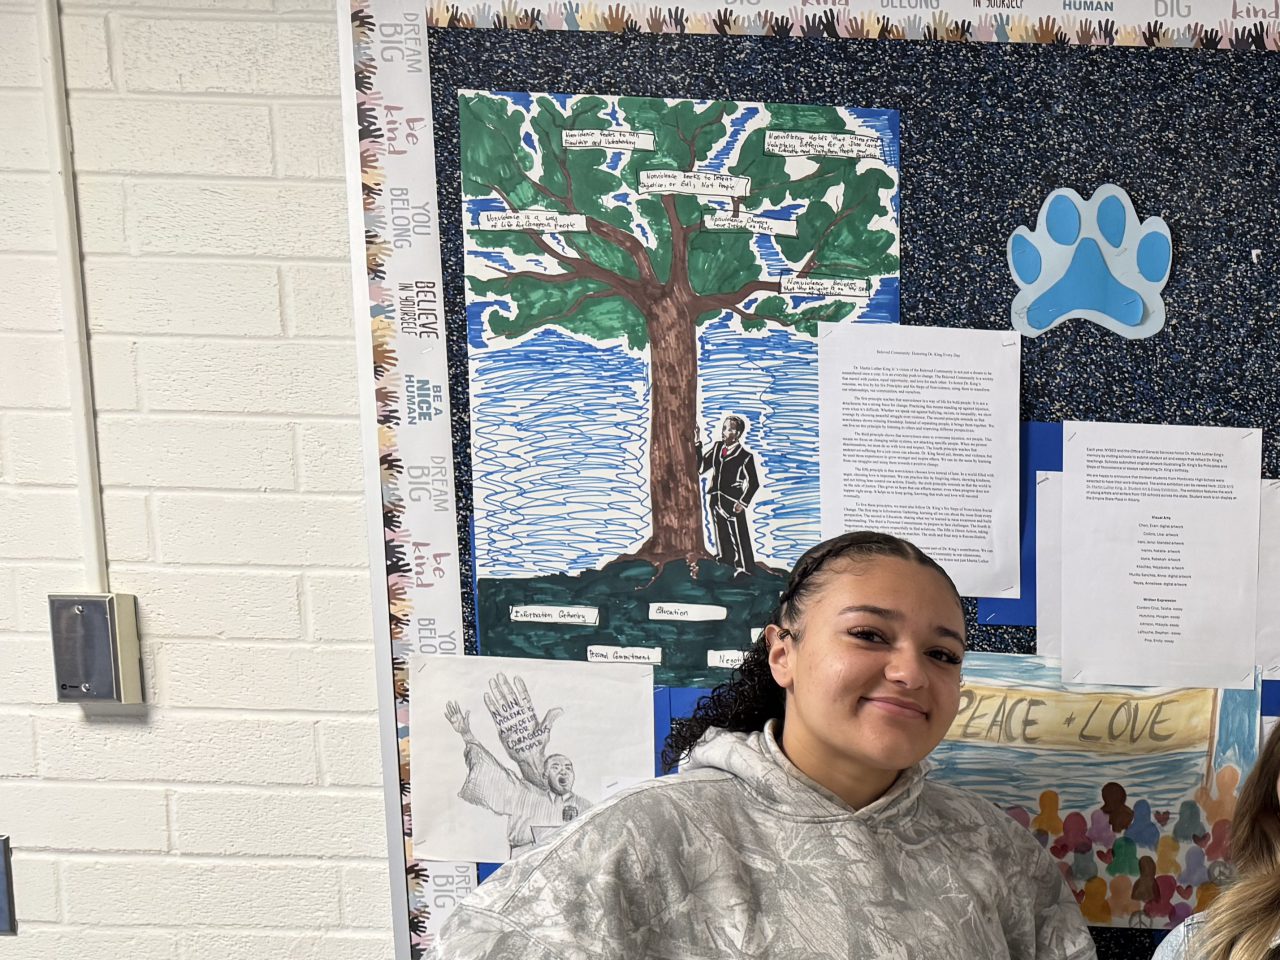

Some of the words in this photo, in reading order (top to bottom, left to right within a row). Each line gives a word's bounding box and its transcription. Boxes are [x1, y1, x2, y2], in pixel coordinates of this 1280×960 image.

[1062, 0, 1113, 12] HUMAN
[1154, 0, 1191, 18] BIG
[1231, 0, 1279, 20] kind
[379, 22, 405, 63] BIG
[403, 12, 423, 73] DREAM
[383, 105, 408, 156] kind
[405, 117, 426, 146] be
[390, 187, 412, 249] BELONG
[411, 201, 431, 236] YOU
[398, 282, 414, 291] IN
[399, 296, 418, 337] YOURSELF
[415, 281, 439, 340] BELIEVE
[404, 374, 417, 425] HUMAN
[416, 379, 433, 422] NICE
[432, 384, 443, 403] BE
[433, 408, 443, 416] A
[407, 465, 432, 503] BIG
[430, 456, 450, 512] DREAM
[412, 541, 435, 589] kind
[433, 551, 452, 579] be
[418, 617, 438, 655] BELO
[957, 688, 1047, 745] PEACE
[1078, 698, 1181, 744] LOVE
[432, 874, 457, 909] BIG
